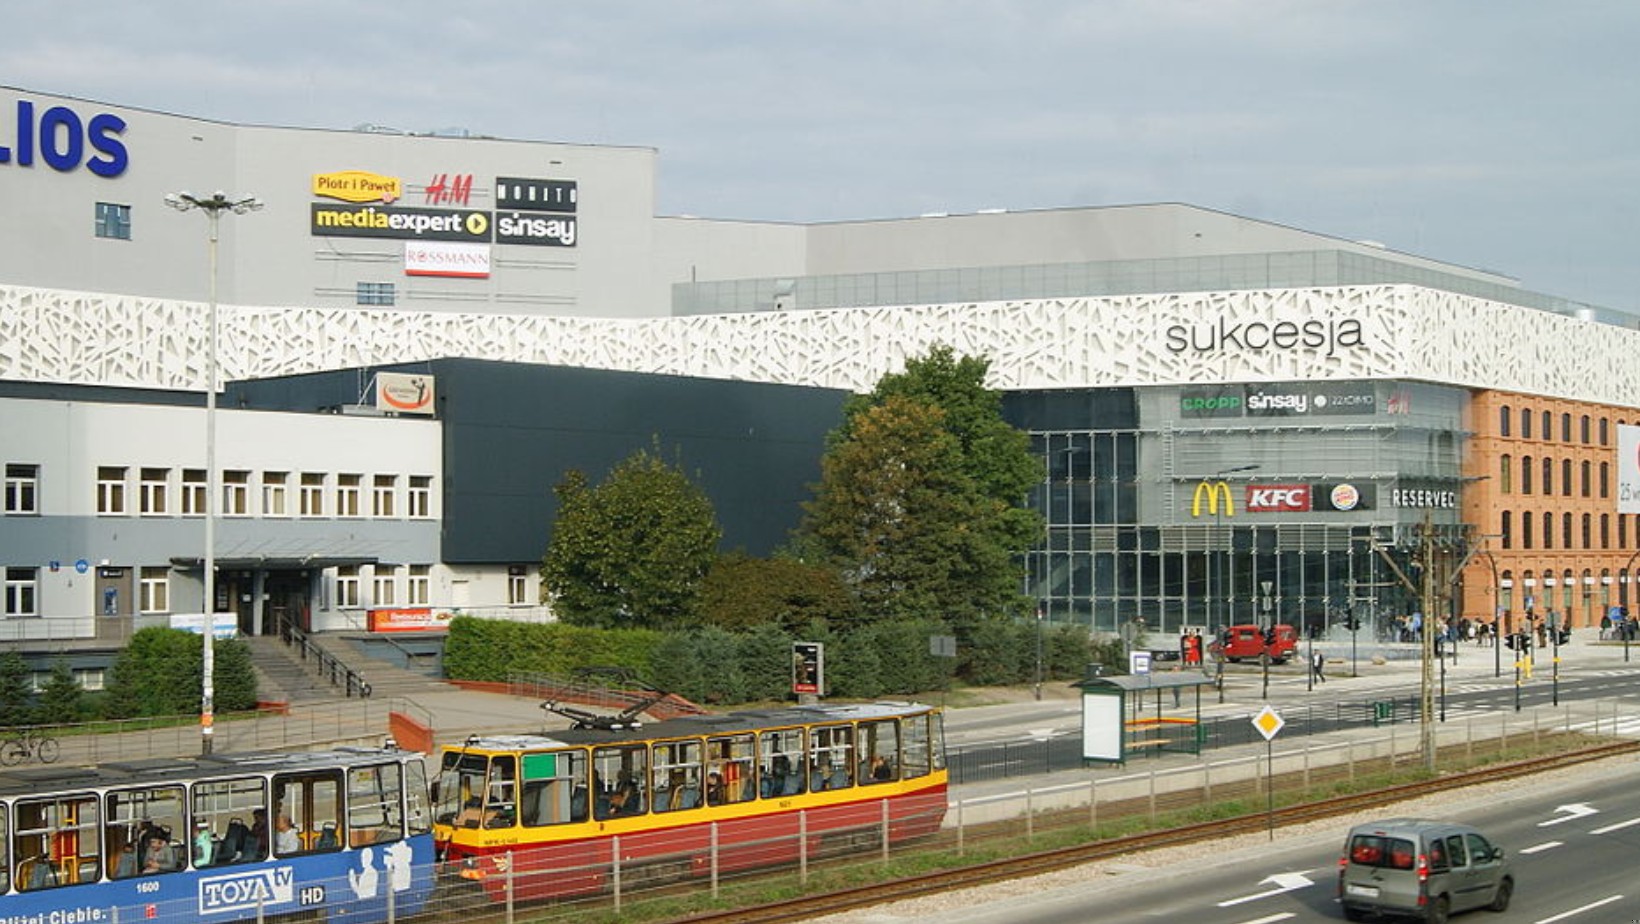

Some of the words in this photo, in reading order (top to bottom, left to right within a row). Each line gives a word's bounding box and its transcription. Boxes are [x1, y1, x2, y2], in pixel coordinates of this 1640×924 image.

[318, 177, 349, 190] Piotr
[360, 179, 396, 192] Paweł
[425, 173, 473, 206] H&M
[316, 207, 462, 234] mediaexpert
[499, 212, 575, 245] sinsay
[407, 249, 489, 265] ROSSMANN
[1166, 311, 1365, 356] sukcesja
[1248, 391, 1307, 413] sinsay
[1249, 489, 1305, 507] KFC
[136, 881, 160, 893] 1600
[205, 877, 270, 906] TOYA
[301, 887, 324, 906] HD
